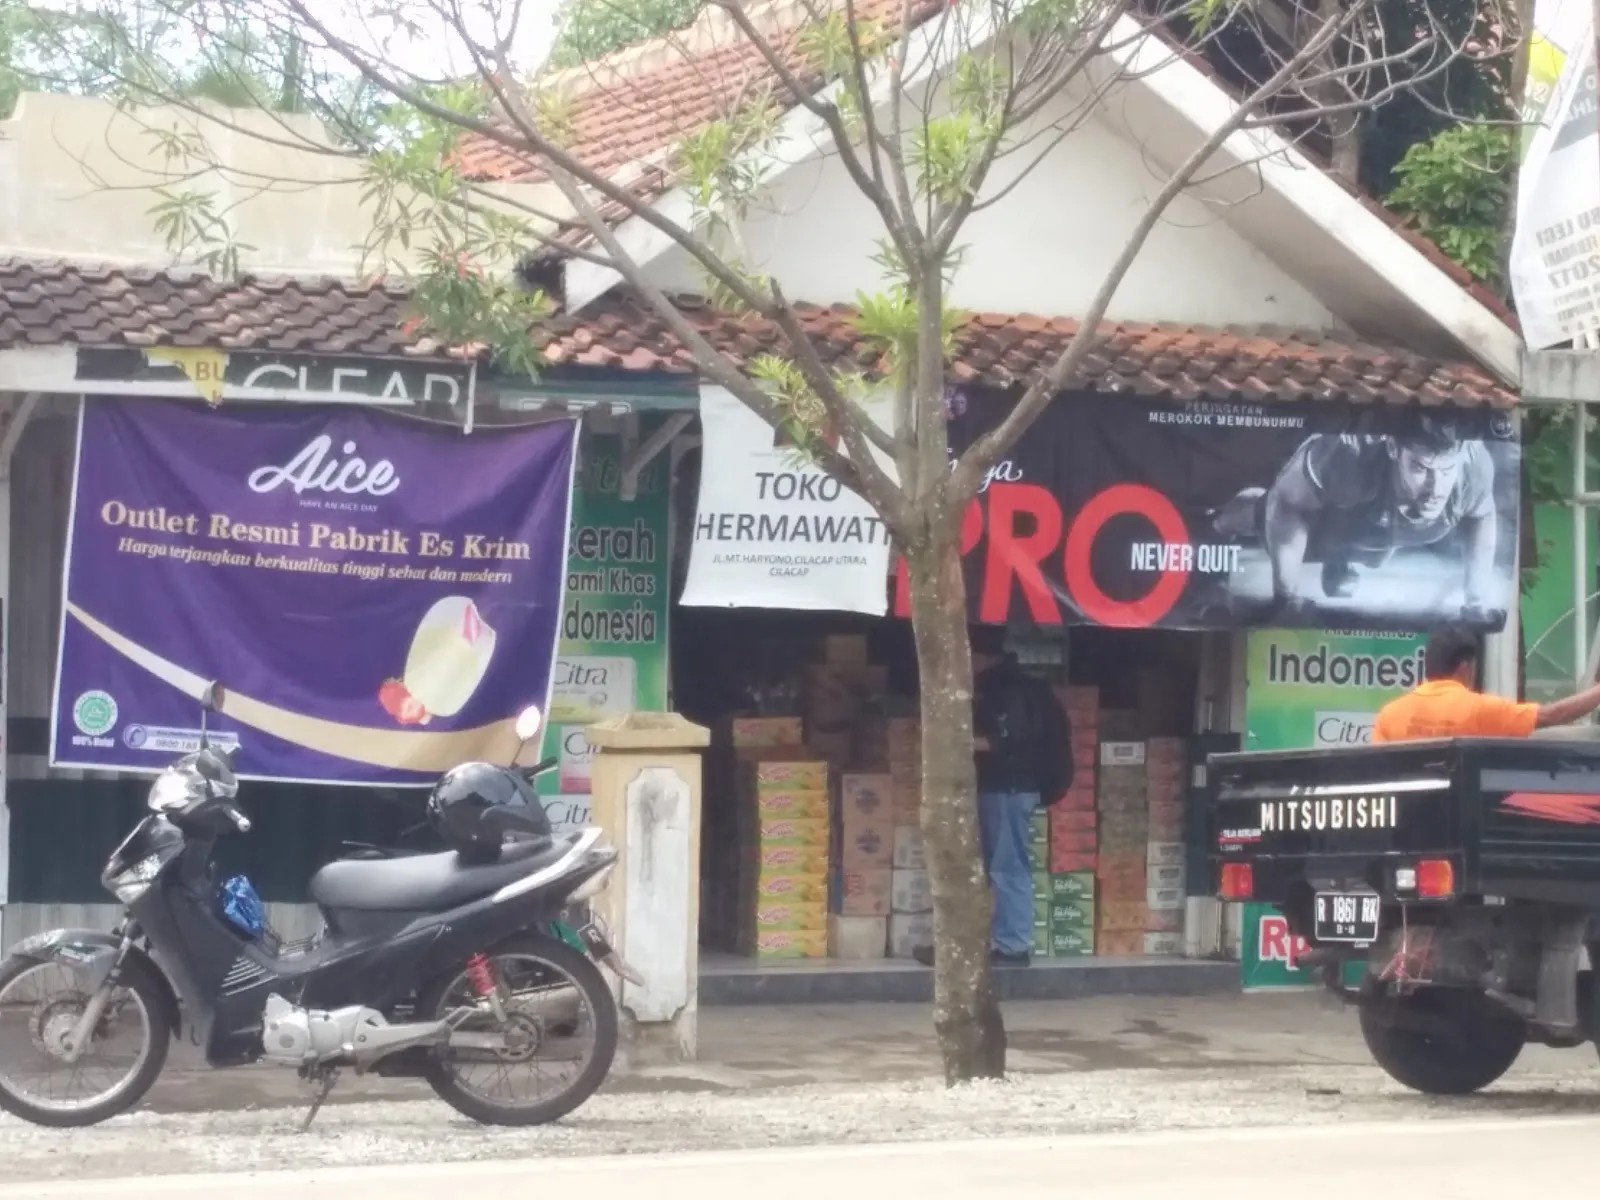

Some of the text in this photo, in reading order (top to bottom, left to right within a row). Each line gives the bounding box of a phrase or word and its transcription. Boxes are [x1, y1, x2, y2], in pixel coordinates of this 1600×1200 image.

[1149, 411, 1211, 424] MEROKOK
[248, 434, 400, 496] Aice
[755, 472, 842, 502] TOKO
[101, 500, 531, 560] Outlet Resmi Pabrik Es Krim
[570, 519, 656, 562] erah
[118, 537, 513, 583] Harga terjangkau berkualitas tinggi sehat dan modern
[1131, 543, 1193, 573] NEVER
[567, 567, 655, 595] ami Khas
[561, 600, 658, 643] donesia
[554, 661, 607, 687] Citra
[1269, 643, 1426, 688] Indonesi
[544, 801, 592, 825] Citr
[1260, 797, 1397, 831] MITSUBISHI
[1318, 897, 1326, 922] R
